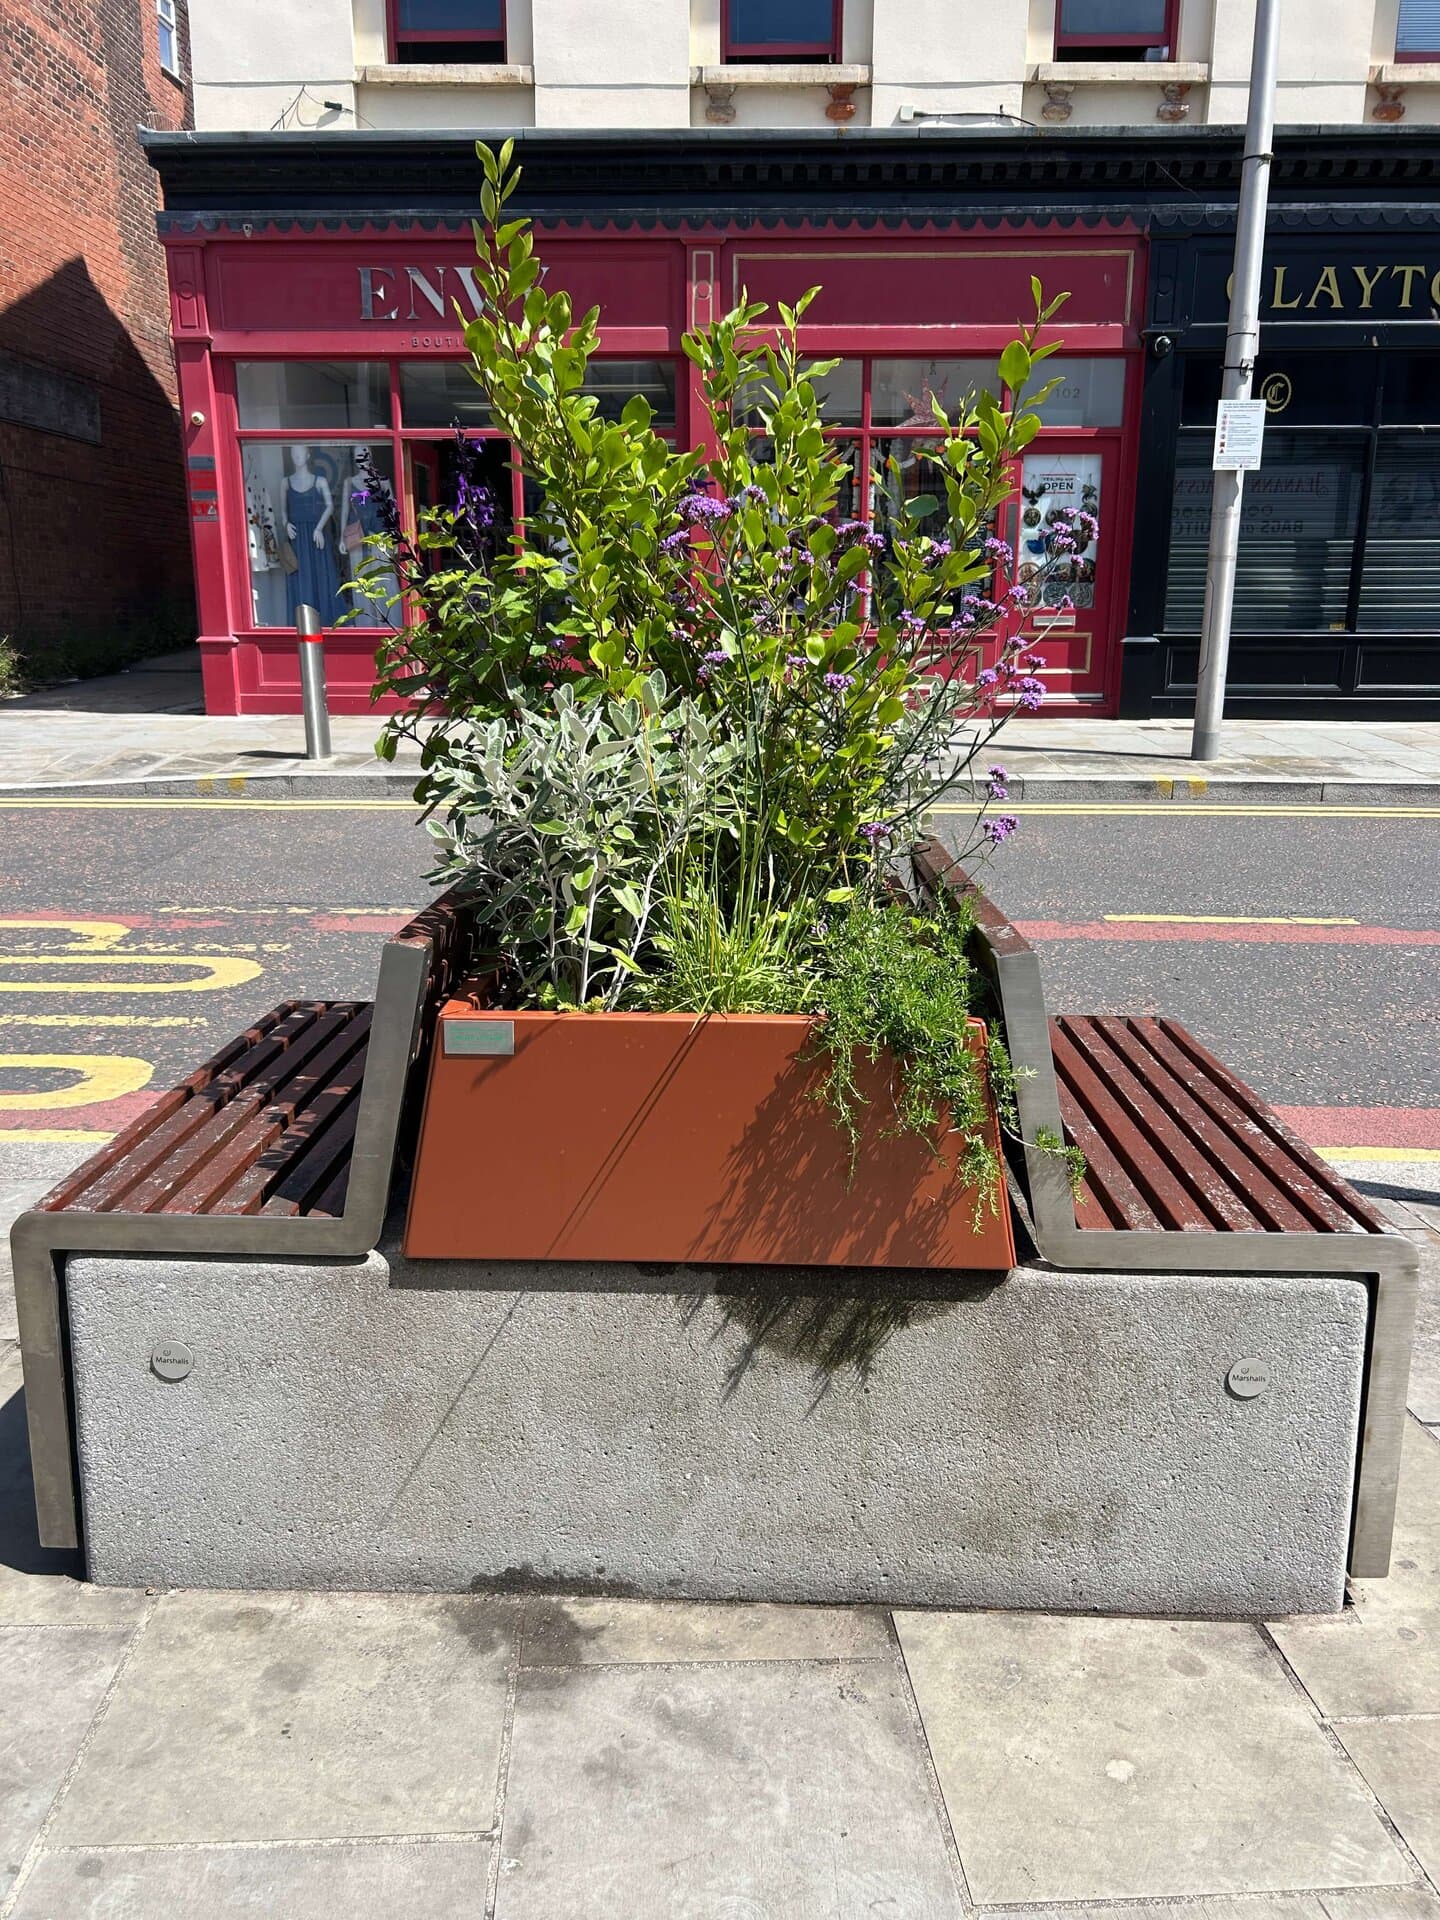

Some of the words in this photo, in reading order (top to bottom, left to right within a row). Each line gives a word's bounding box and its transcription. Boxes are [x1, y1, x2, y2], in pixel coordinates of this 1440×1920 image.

[1226, 265, 1440, 308] LAYT
[357, 266, 550, 320] ENV
[411, 336, 466, 348] BOUTI
[1055, 387, 1080, 400] 102
[1043, 482, 1074, 490] OPEN
[155, 1356, 189, 1365] Marshalls
[1232, 1374, 1266, 1382] Marshalls
